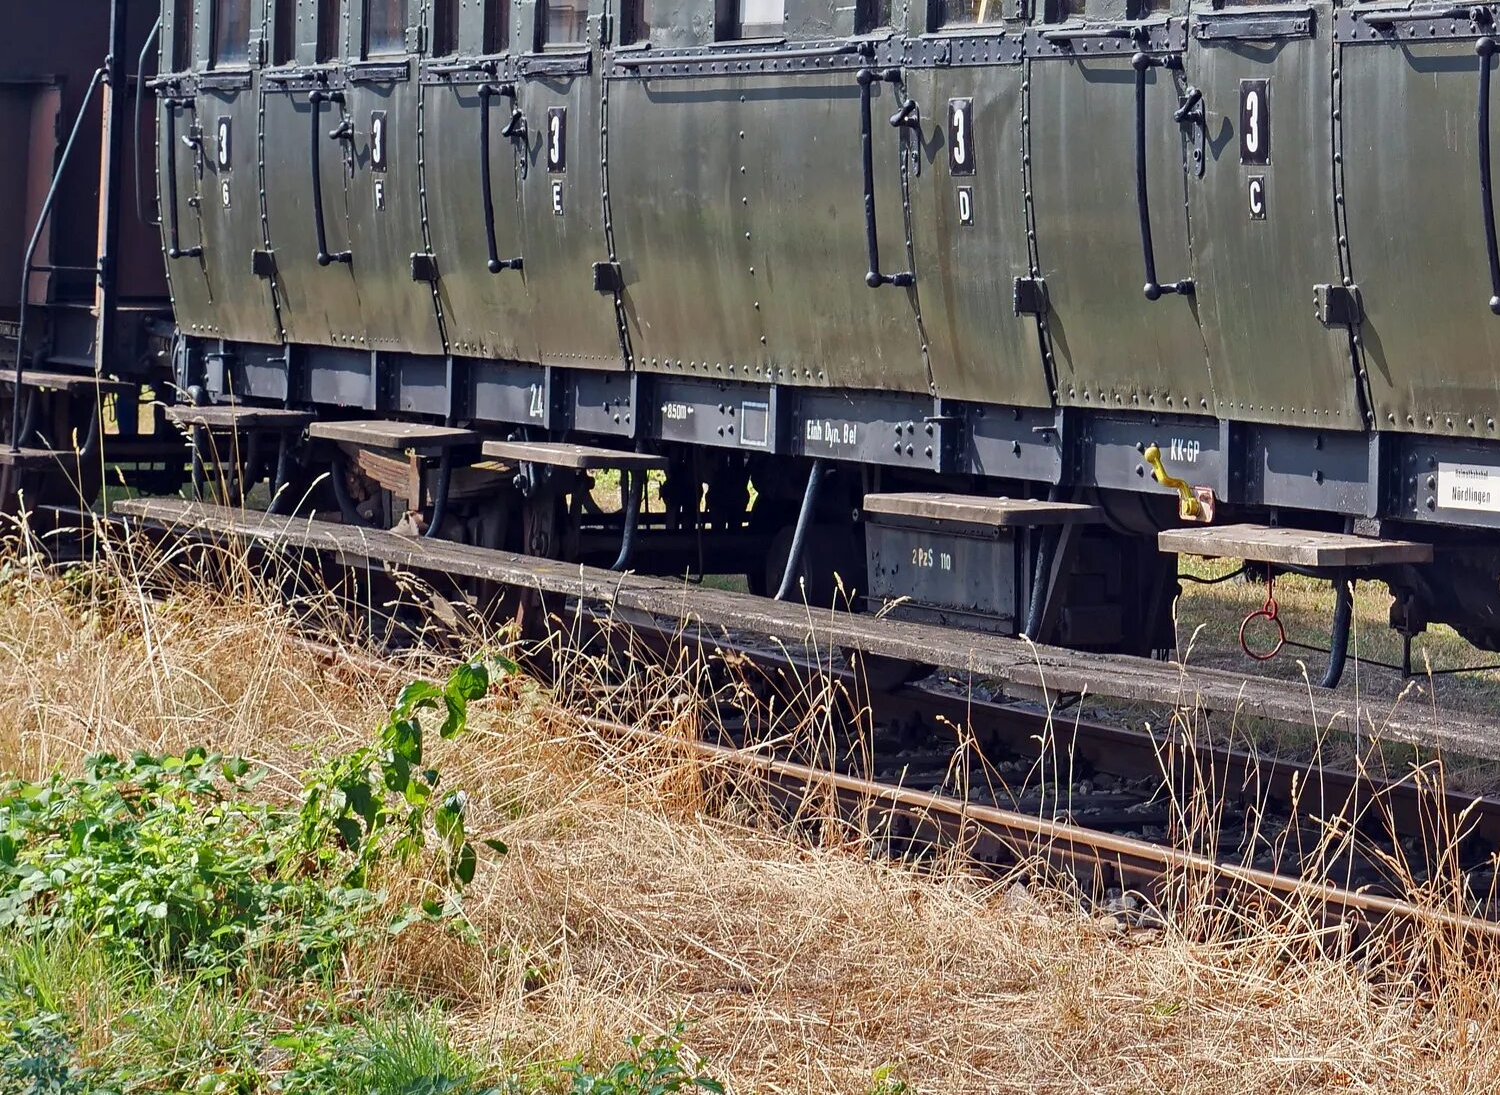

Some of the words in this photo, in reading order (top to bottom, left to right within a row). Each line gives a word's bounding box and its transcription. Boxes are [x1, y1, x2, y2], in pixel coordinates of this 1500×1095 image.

[953, 109, 965, 164] 3
[1246, 90, 1259, 153] 3
[219, 123, 227, 165] 3
[373, 118, 382, 163] 3
[550, 116, 560, 164] 3
[222, 182, 230, 205] G
[375, 183, 382, 207] F
[553, 185, 562, 211] E
[959, 191, 970, 221] D
[1250, 180, 1262, 214] C
[529, 383, 544, 418] 24
[843, 423, 857, 445] Bel
[1170, 437, 1200, 463] KK-GP
[1452, 486, 1491, 505] Nördlingen
[912, 548, 917, 565] 2
